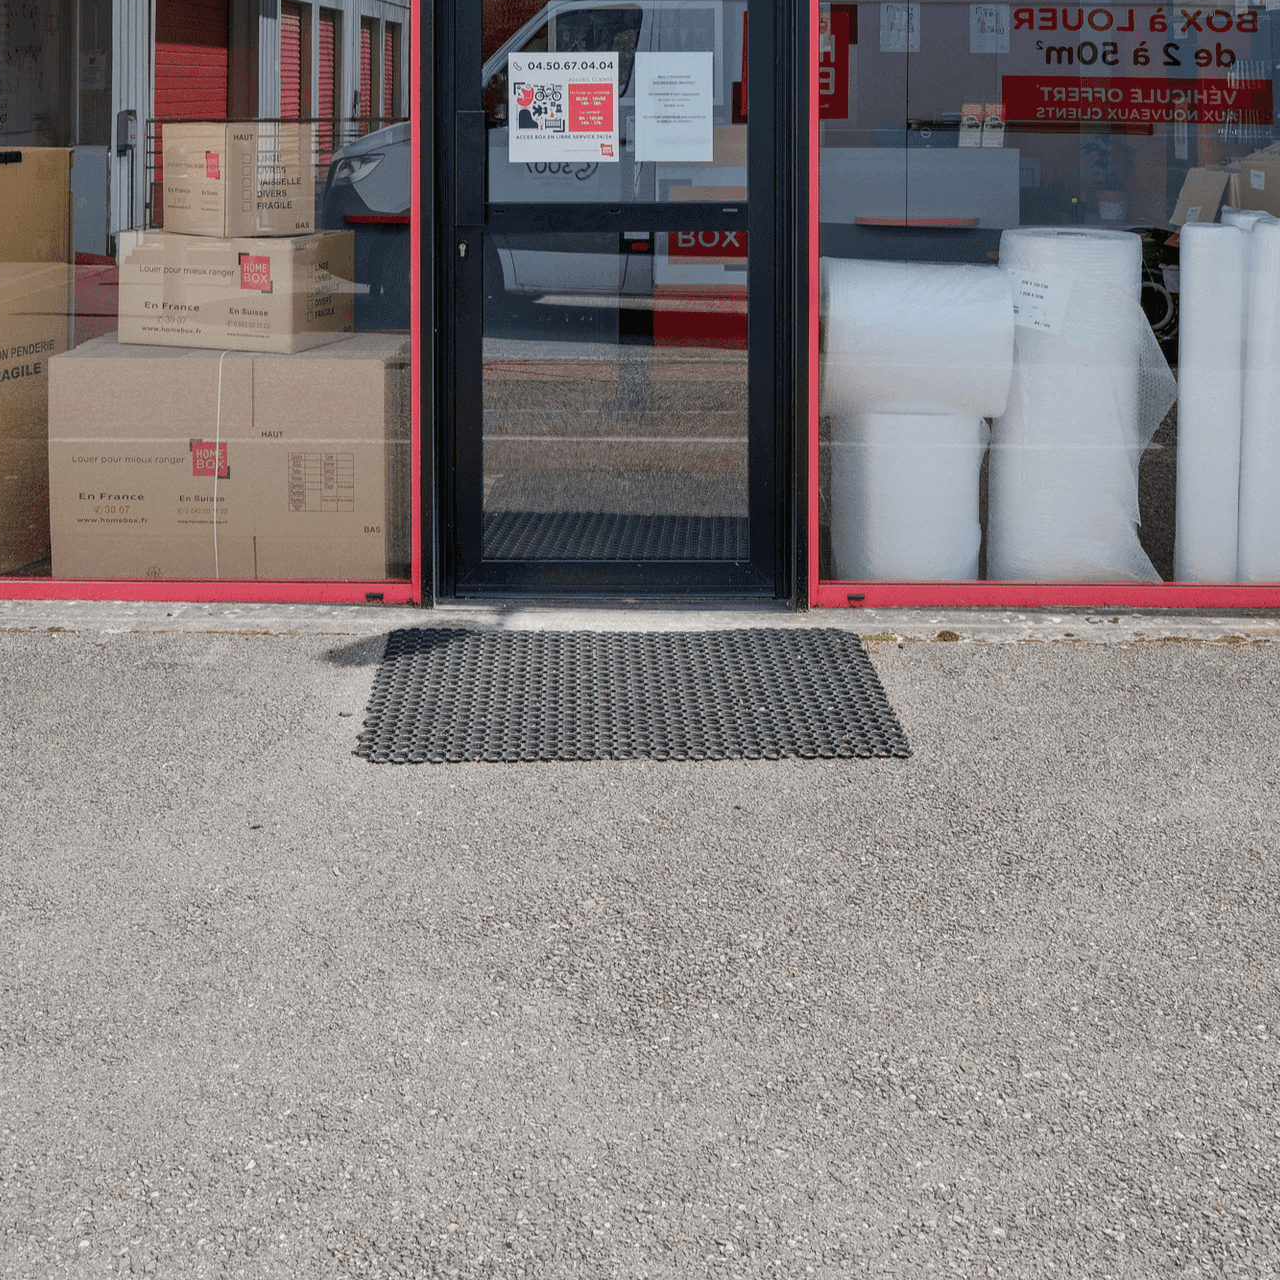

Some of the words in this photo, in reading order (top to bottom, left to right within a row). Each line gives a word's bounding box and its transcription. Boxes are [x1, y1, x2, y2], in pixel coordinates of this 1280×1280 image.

[528, 62, 613, 70] 04.50.67.04.04
[258, 154, 281, 162] LINGE
[257, 166, 286, 174] LIVRES
[258, 178, 302, 186] VAISSELLE
[257, 190, 287, 198] DIVERS
[257, 201, 292, 210] FRAGILE
[678, 232, 740, 247] BOX
[244, 263, 267, 273] HOME
[315, 261, 328, 271] LINGE
[184, 267, 206, 275] mieux
[209, 269, 234, 277] ranger
[244, 273, 267, 283] BOX
[145, 301, 158, 309] En
[162, 302, 200, 311] France
[315, 296, 332, 307] DIVERS
[242, 308, 268, 316] Suisse
[315, 307, 335, 318] FRAGILE
[177, 316, 187, 324] 07
[142, 326, 202, 334] www.homebox.fr
[11, 339, 55, 358] PENDERIE
[196, 450, 223, 458] HOME
[72, 455, 98, 463] Louer
[196, 460, 224, 469] BOX
[79, 492, 95, 500] En
[100, 493, 144, 501] France
[104, 506, 115, 514] 30
[119, 506, 130, 514] 07
